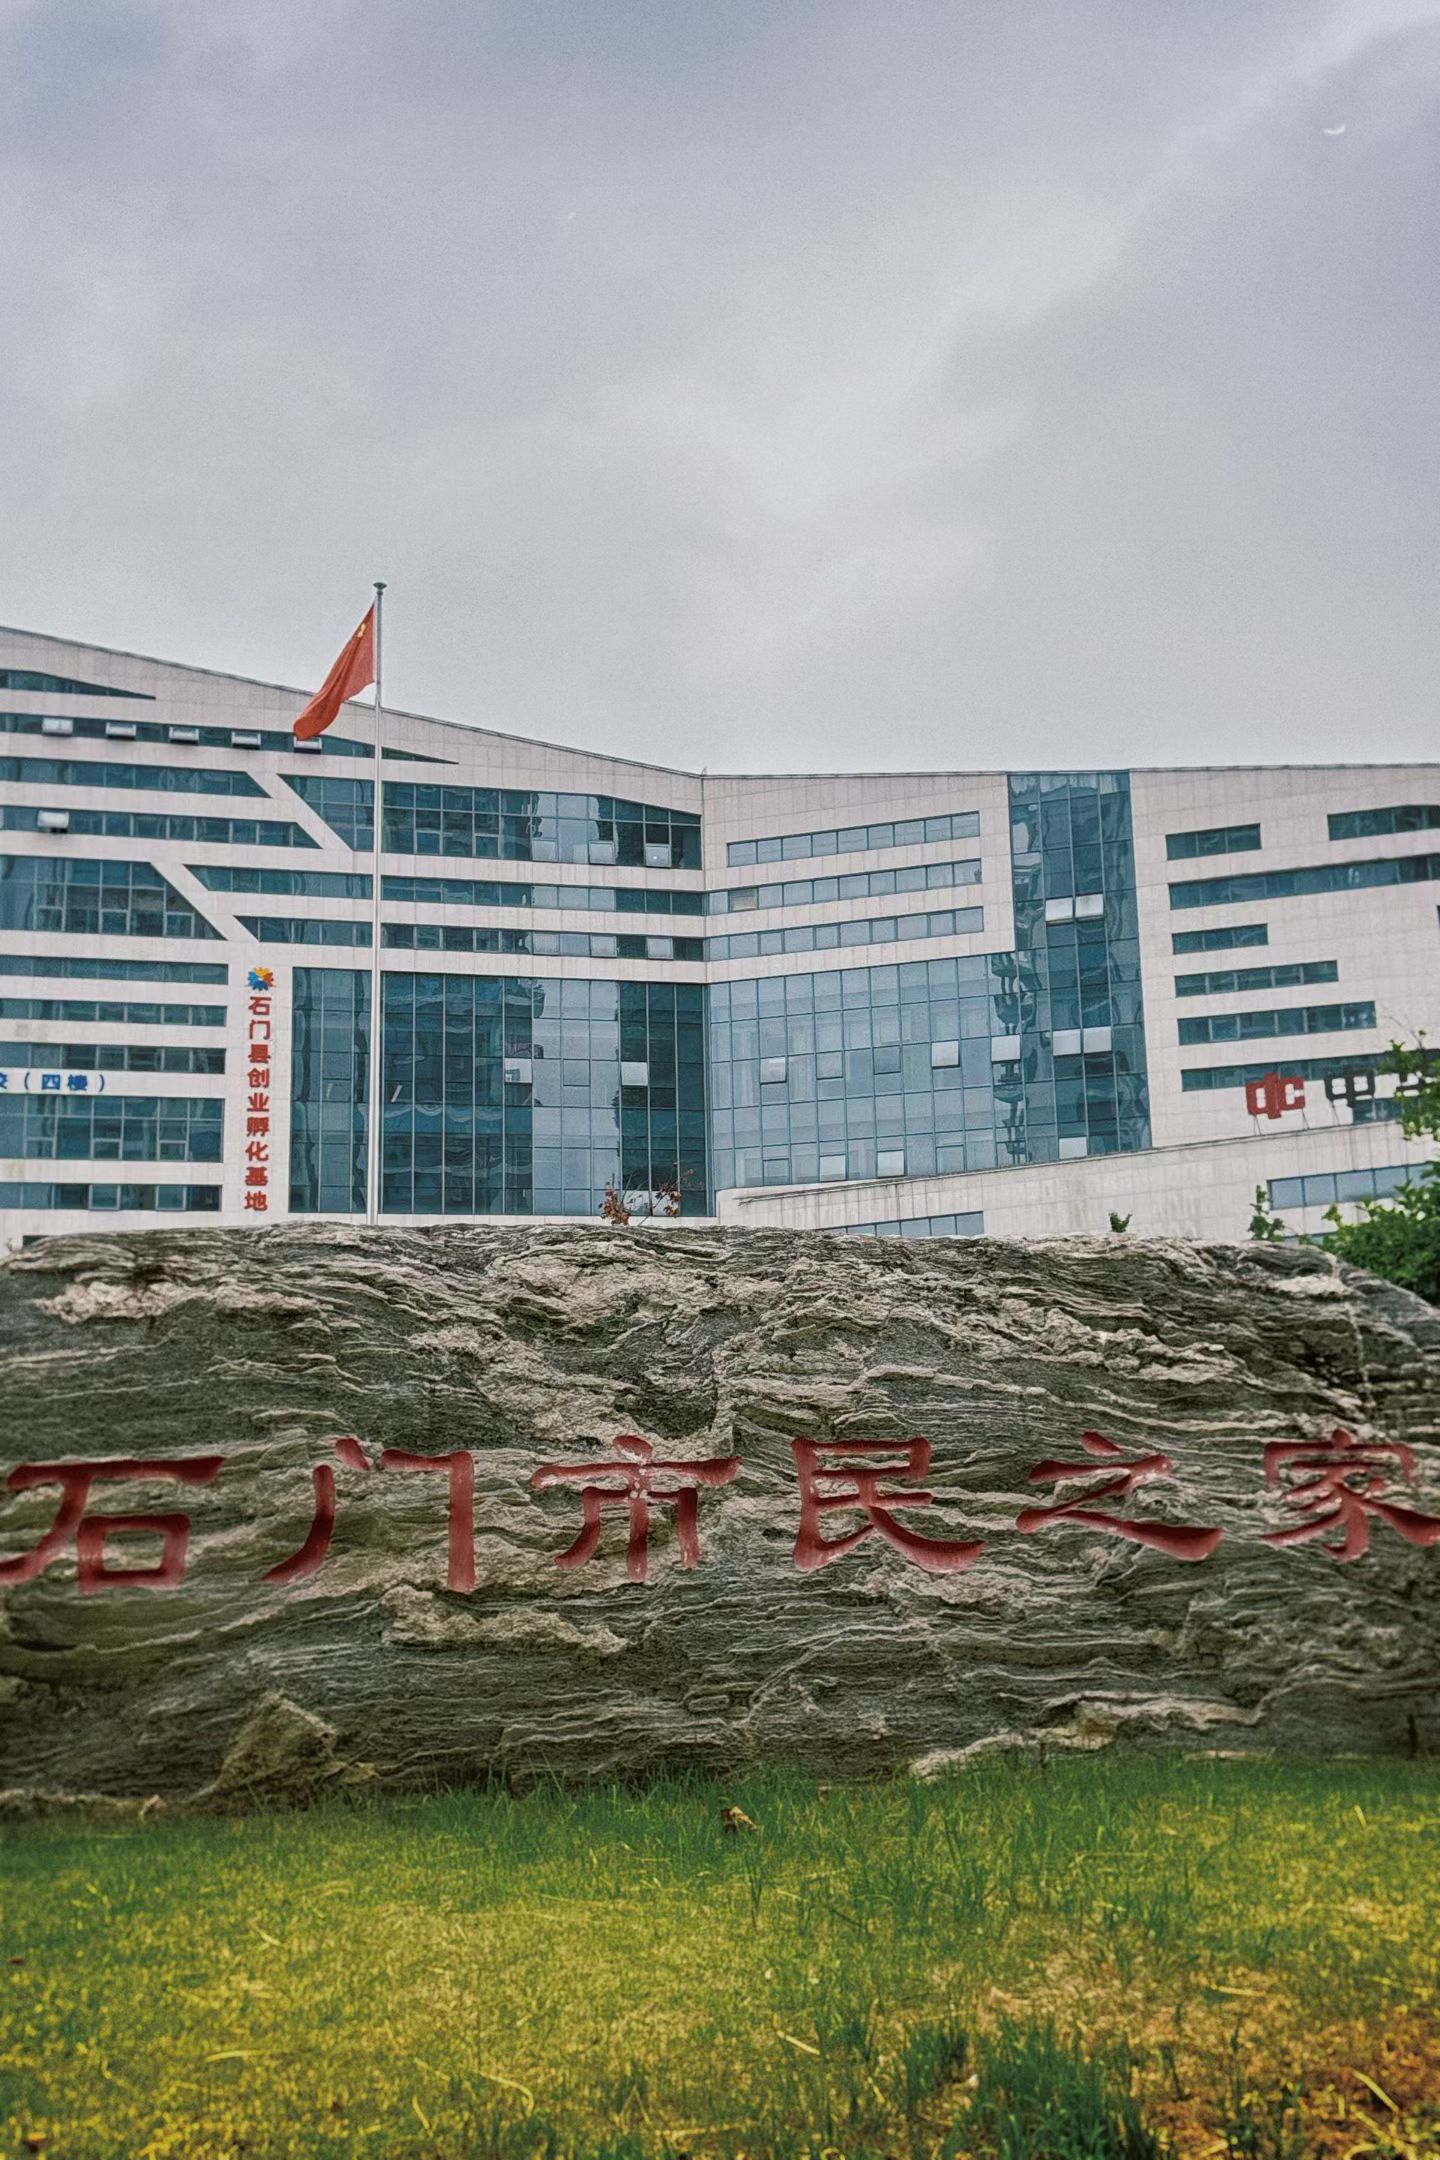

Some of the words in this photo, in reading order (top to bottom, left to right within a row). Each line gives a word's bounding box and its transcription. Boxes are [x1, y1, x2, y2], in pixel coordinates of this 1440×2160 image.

[244, 996, 272, 1212] 石门县创业孵化基地
[0, 1428, 1440, 1595] 石门市民之家
